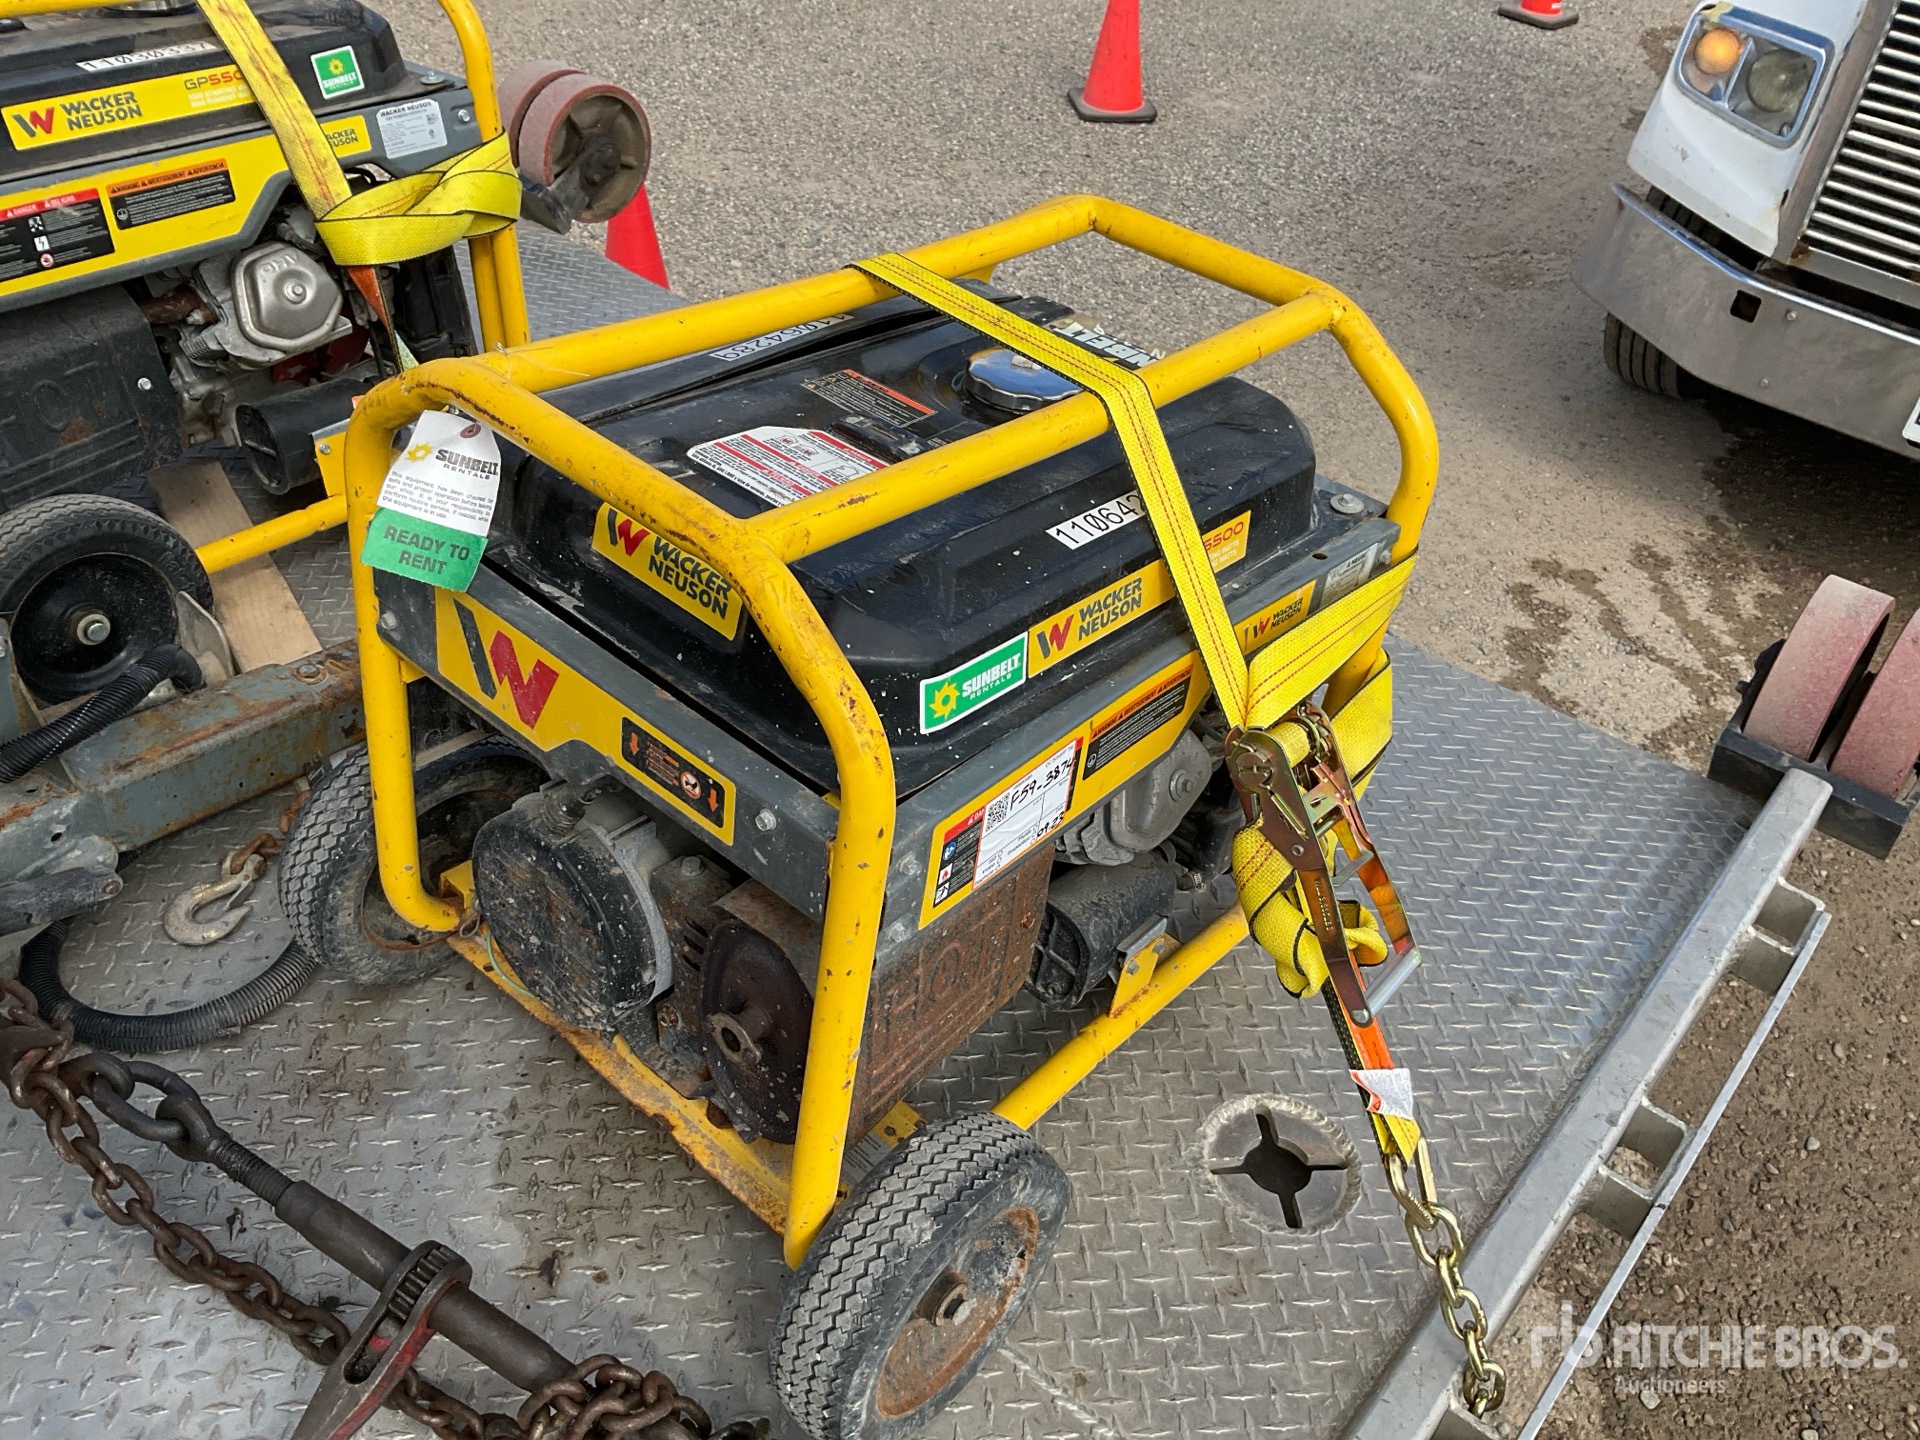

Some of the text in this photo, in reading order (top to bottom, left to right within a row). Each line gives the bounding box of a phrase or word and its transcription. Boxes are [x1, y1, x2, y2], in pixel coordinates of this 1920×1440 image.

[184, 70, 244, 90] GP550
[323, 72, 357, 89] SUNBELT
[60, 91, 138, 116] WACKER
[380, 107, 406, 117] WACKER
[407, 101, 432, 112] NEUSON
[67, 104, 142, 131] NEUSON
[326, 128, 355, 141] ACKER
[328, 136, 358, 149] EUSON
[436, 448, 499, 475] SUNBELT
[443, 463, 490, 480] RENTALS
[405, 475, 434, 489] equipment
[393, 498, 423, 514] equipment
[383, 525, 470, 561] READY TO
[398, 550, 447, 575] RENT
[653, 535, 732, 602] WACKER
[648, 554, 728, 620] NEUSON
[1078, 577, 1143, 623] WACKER
[1272, 597, 1303, 620] WACKER
[1078, 594, 1142, 641] NEUSON
[1270, 607, 1302, 630] NEUSON
[962, 653, 1021, 698] SUNBELT
[969, 674, 1012, 700] RENTALS
